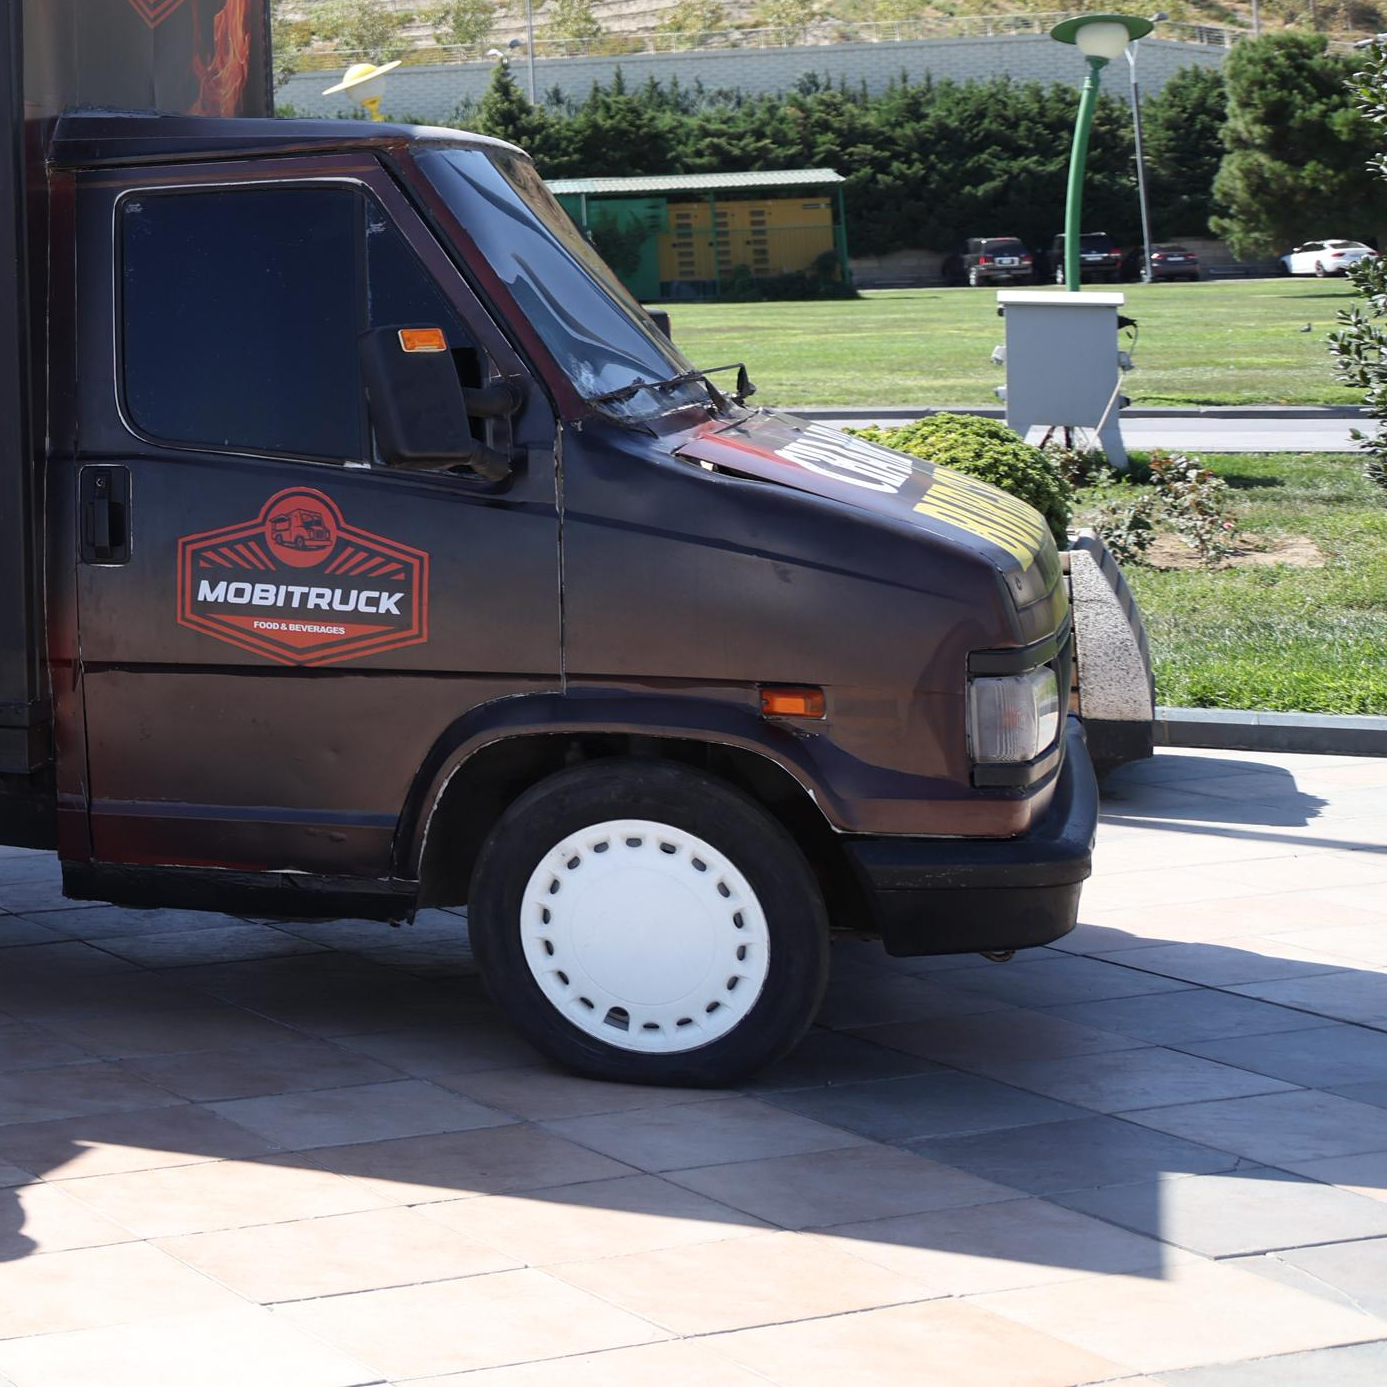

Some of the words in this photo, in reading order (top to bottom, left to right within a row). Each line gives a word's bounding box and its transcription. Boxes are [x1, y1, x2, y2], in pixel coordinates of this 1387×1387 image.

[197, 580, 405, 615] MOBITRUCK
[254, 621, 279, 631] FOOD
[289, 624, 345, 635] BEVERAGES
